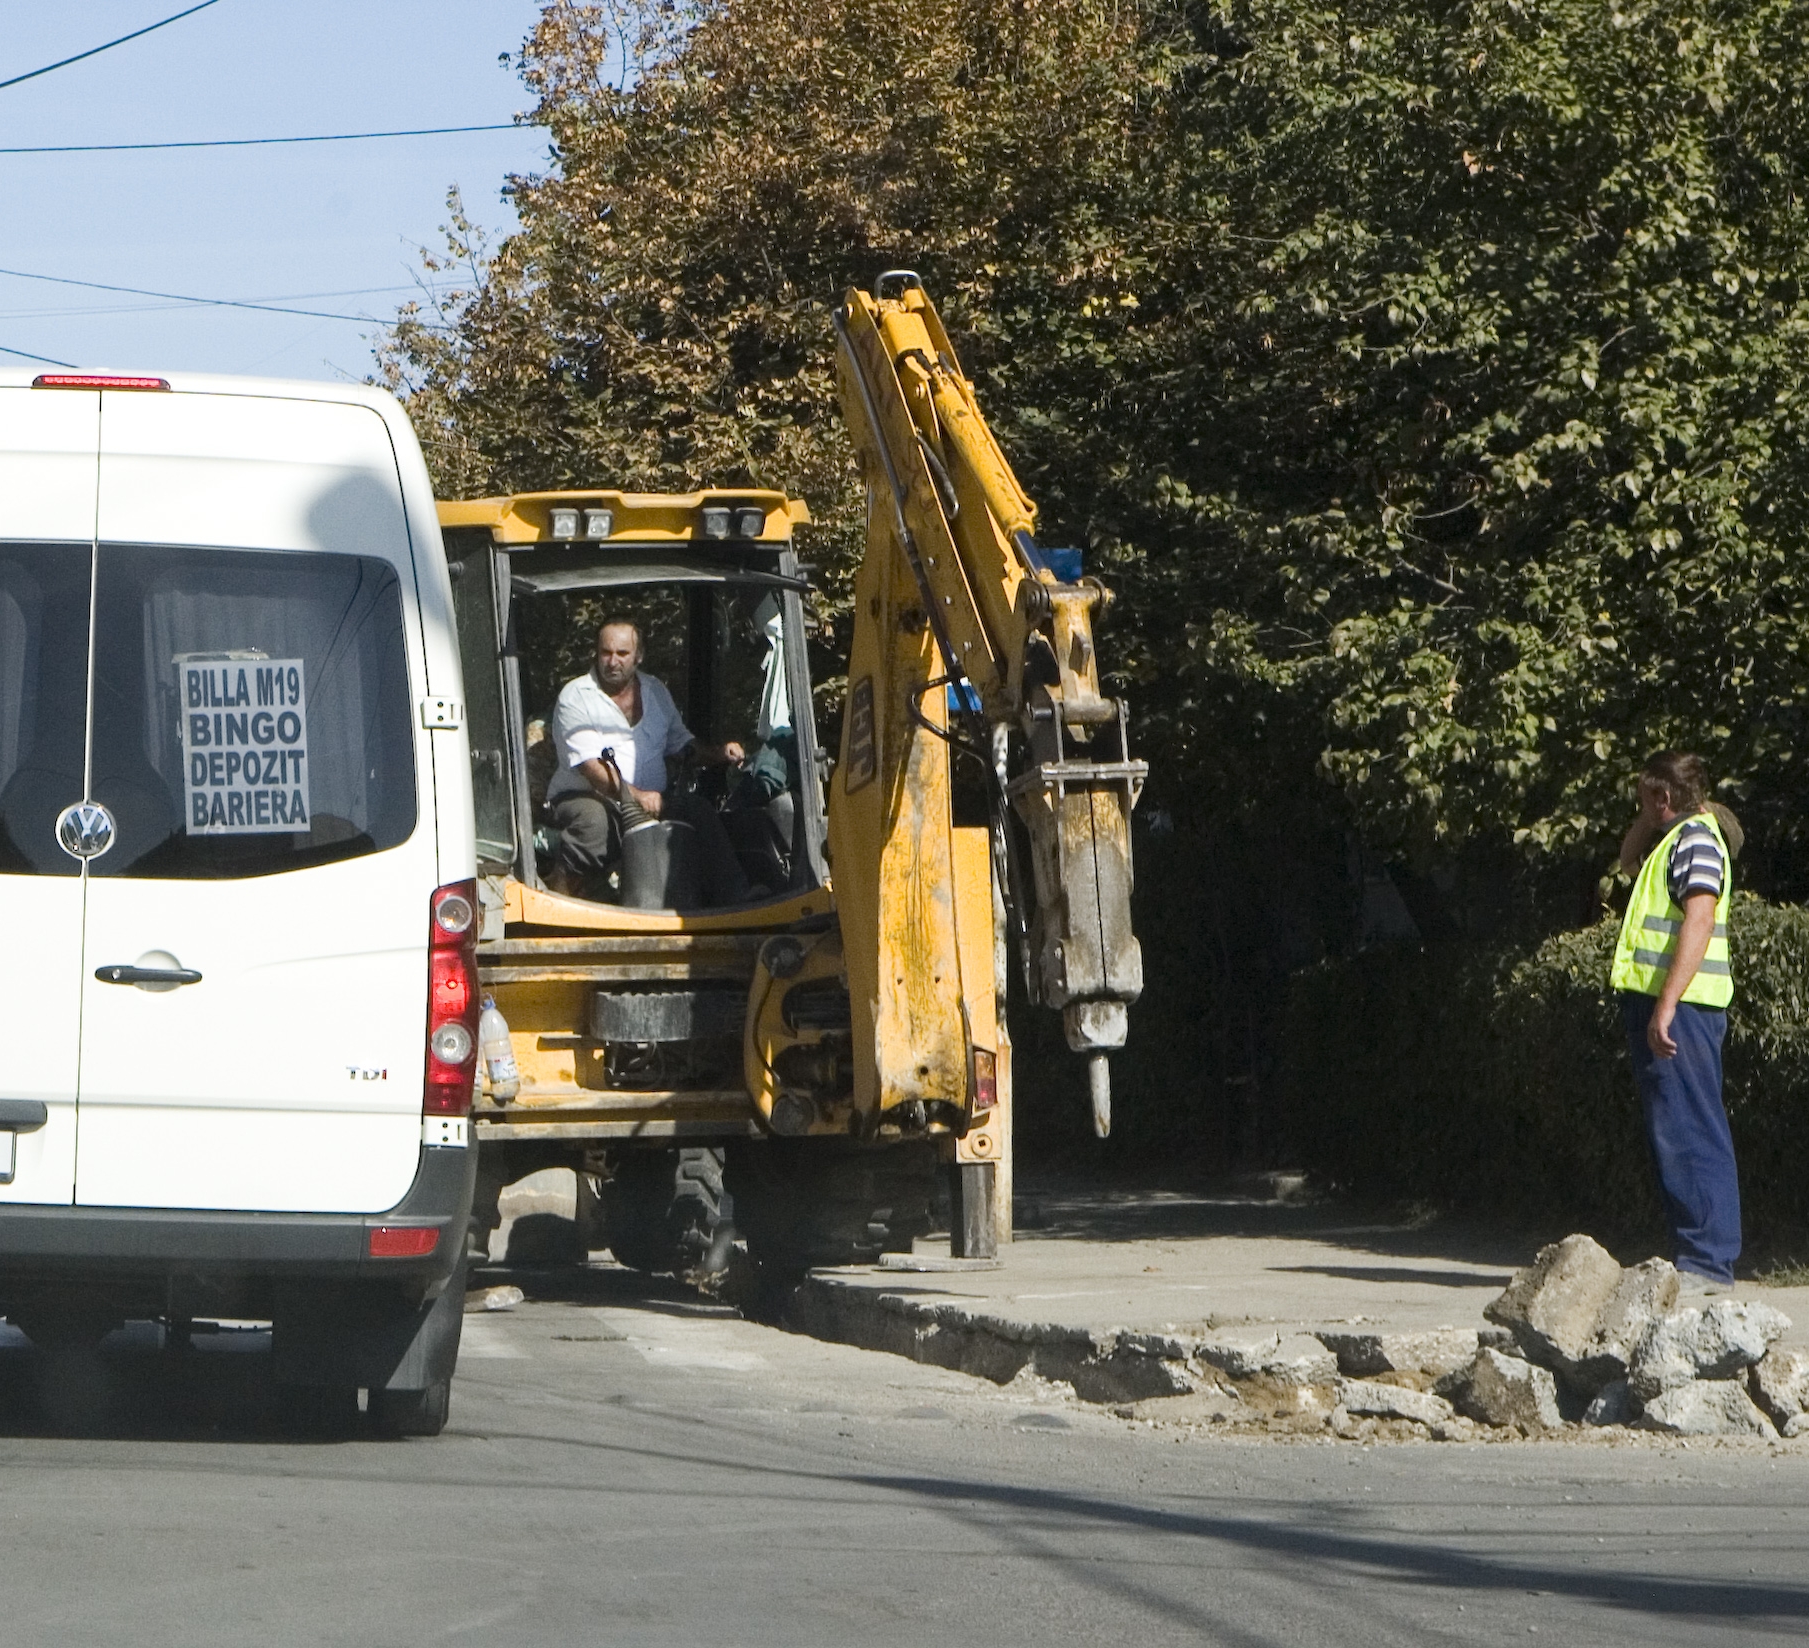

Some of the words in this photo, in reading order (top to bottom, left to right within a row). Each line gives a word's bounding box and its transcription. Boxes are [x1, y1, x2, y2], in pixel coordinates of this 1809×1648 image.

[187, 668, 251, 709] BILLA
[256, 666, 300, 706] M19
[189, 711, 302, 746] BINGO
[191, 749, 305, 787] DEPOZIT
[192, 789, 308, 827] BARIERA
